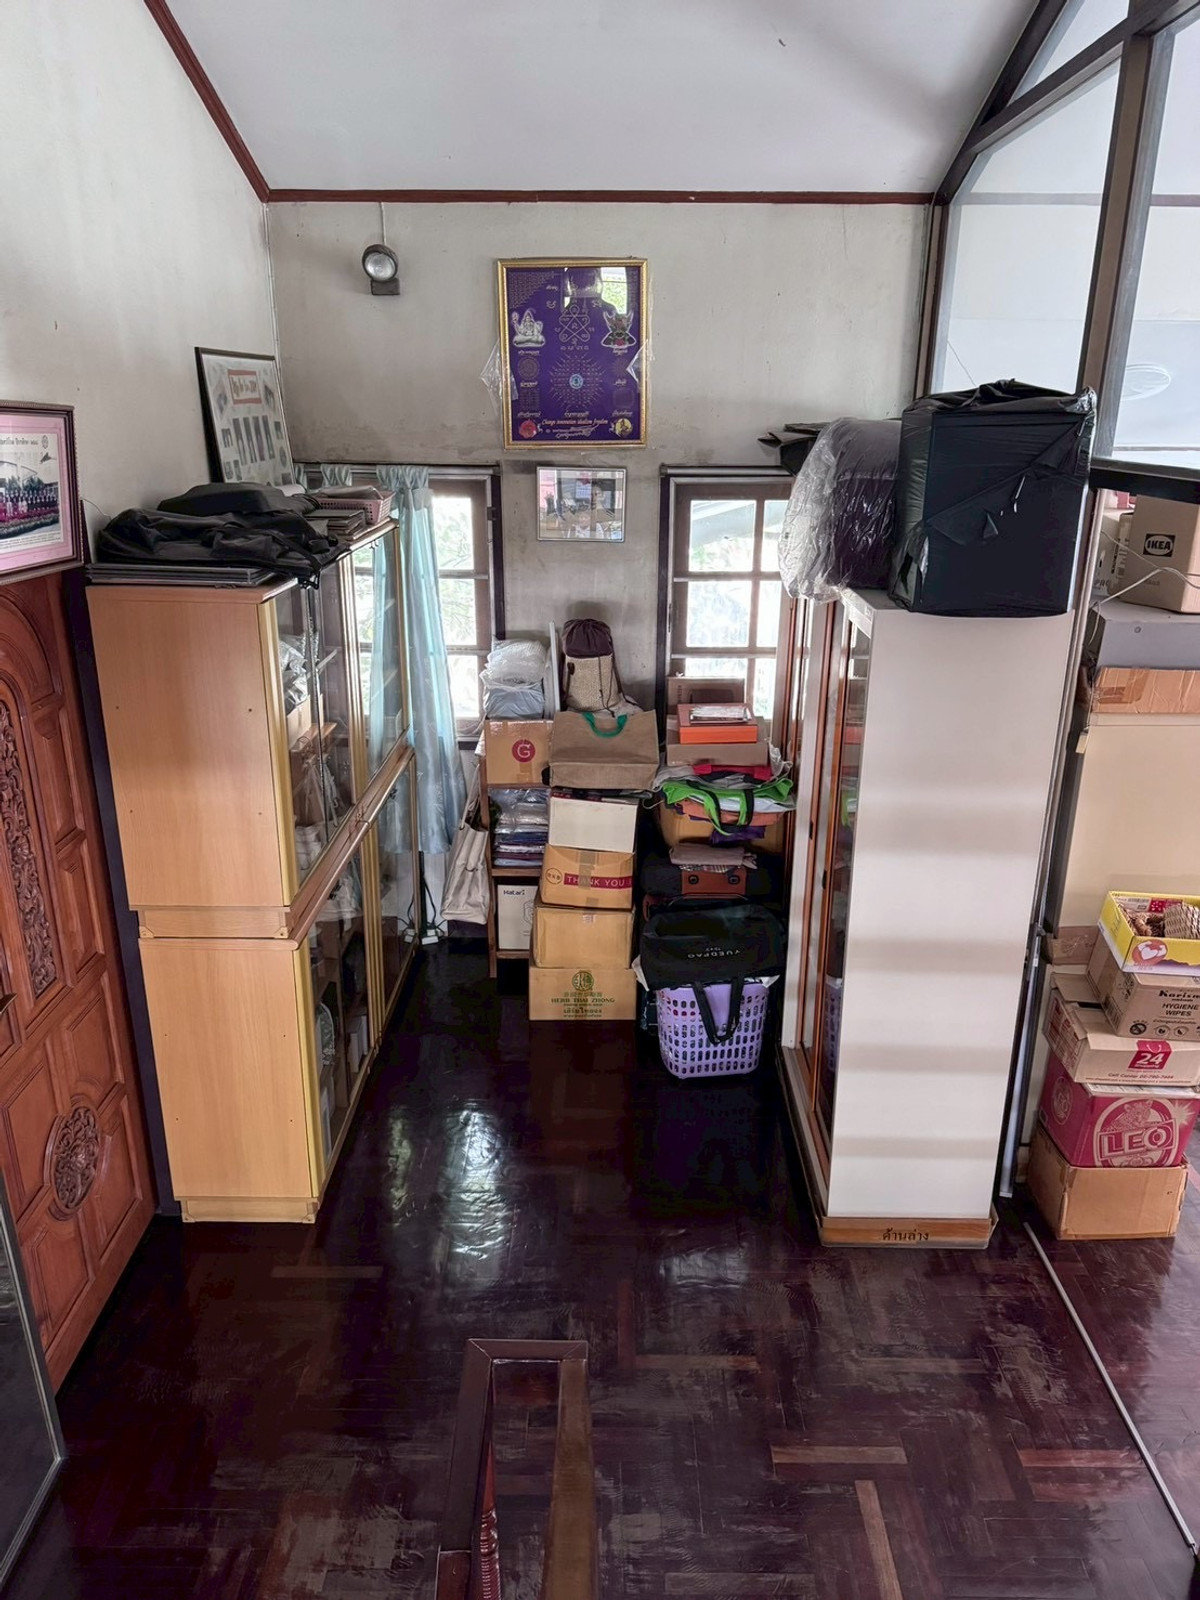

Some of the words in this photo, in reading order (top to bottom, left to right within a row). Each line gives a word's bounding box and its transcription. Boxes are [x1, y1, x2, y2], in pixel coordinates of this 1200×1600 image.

[1147, 540, 1171, 550] IKEA
[517, 743, 531, 759] G
[604, 878, 626, 888] YOU
[1162, 1003, 1199, 1011] HYGIENE
[1136, 1052, 1165, 1065] 24
[1101, 1125, 1170, 1158] LEO
